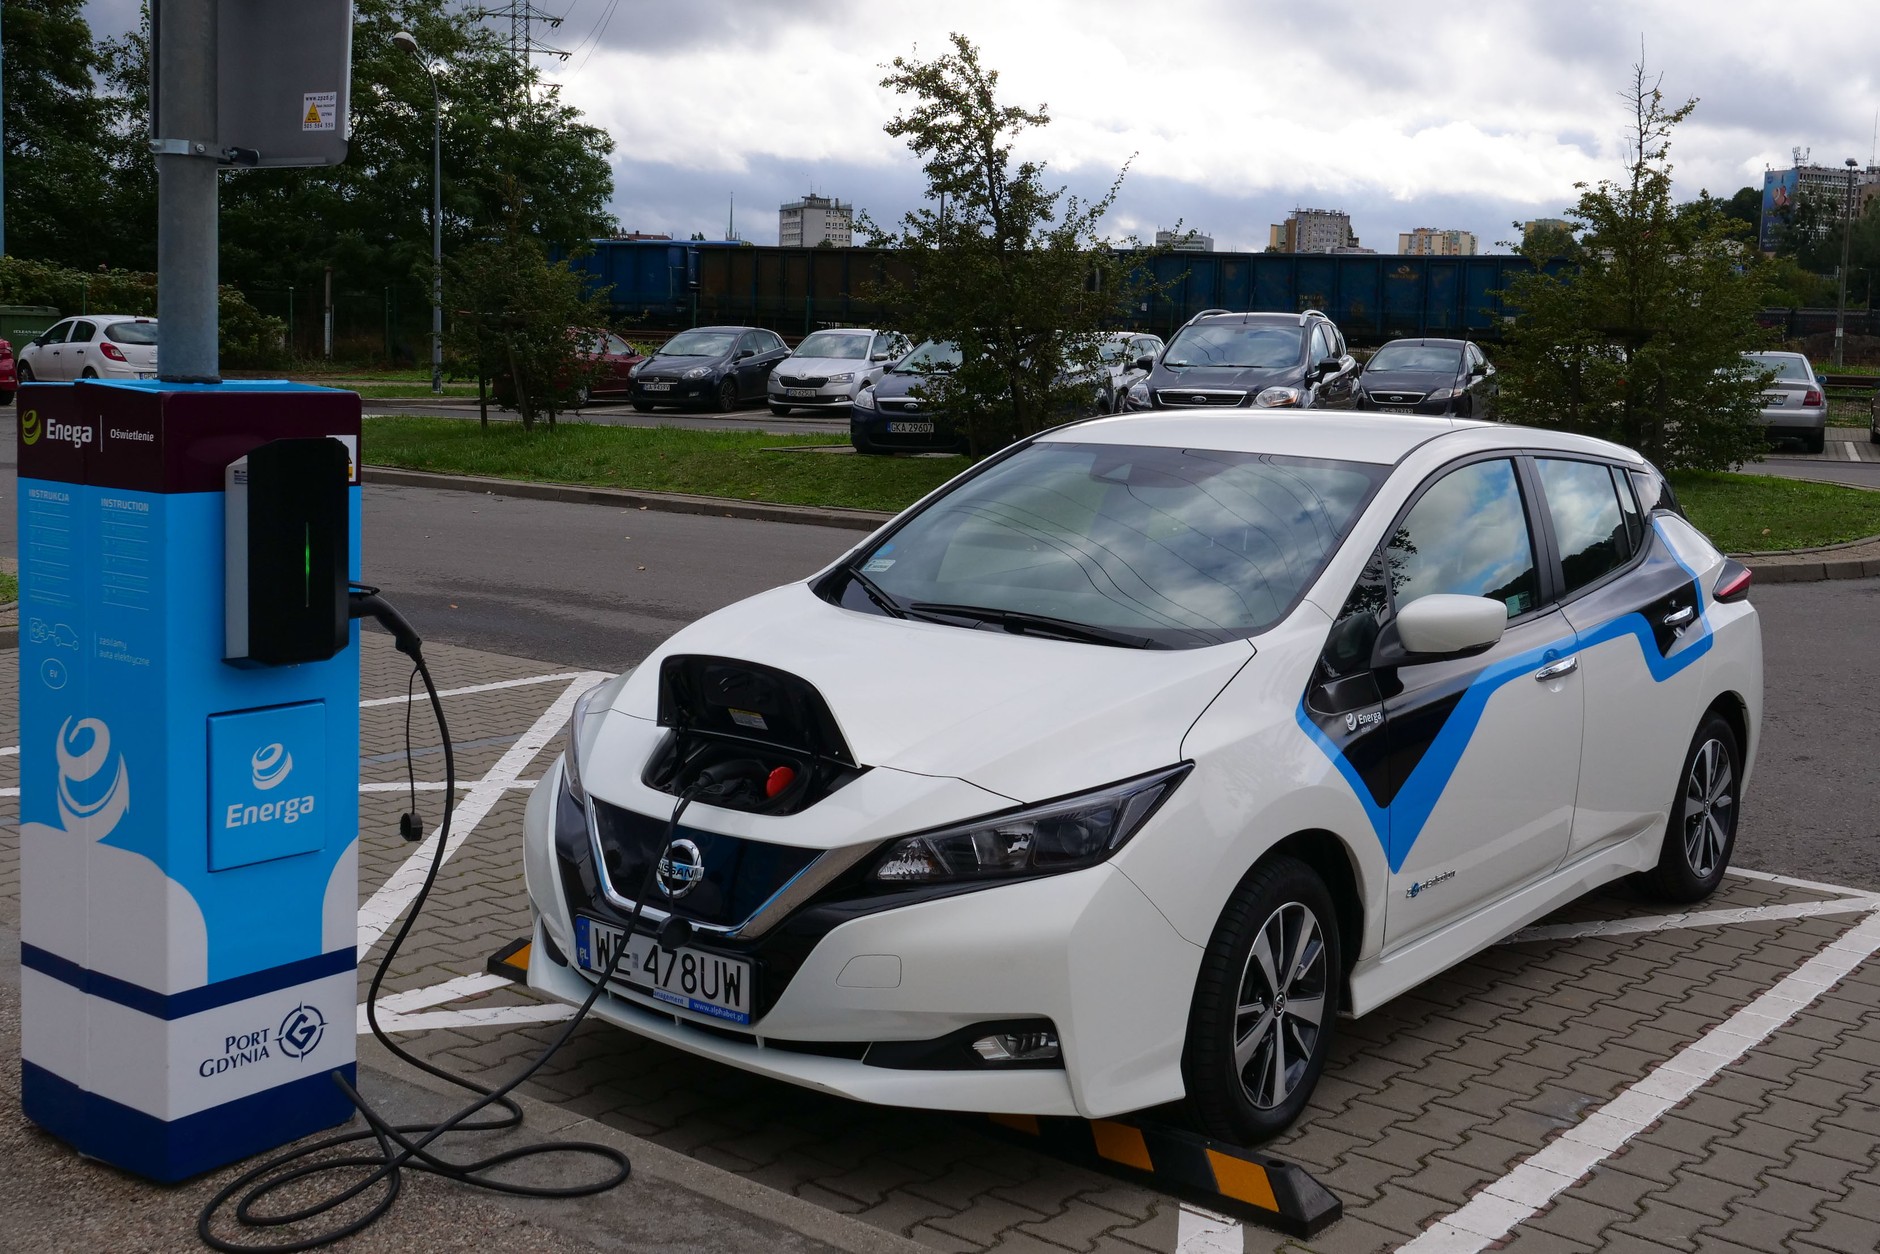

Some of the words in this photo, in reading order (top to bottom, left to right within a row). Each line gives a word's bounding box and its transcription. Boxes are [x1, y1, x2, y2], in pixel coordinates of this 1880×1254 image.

[110, 428, 154, 442] Oświetlenie
[891, 422, 907, 432] GKA
[908, 422, 933, 433] 29607
[28, 488, 70, 502] INSTRUKCJA
[101, 498, 149, 512] INSTRUCTION
[1358, 711, 1382, 724] Energa
[225, 795, 315, 829] Energa
[643, 944, 741, 1007] 478UW
[693, 1002, 744, 1022] www.alphabet.pl
[225, 1027, 270, 1054] PORT
[199, 1045, 270, 1078] GDYNIA
